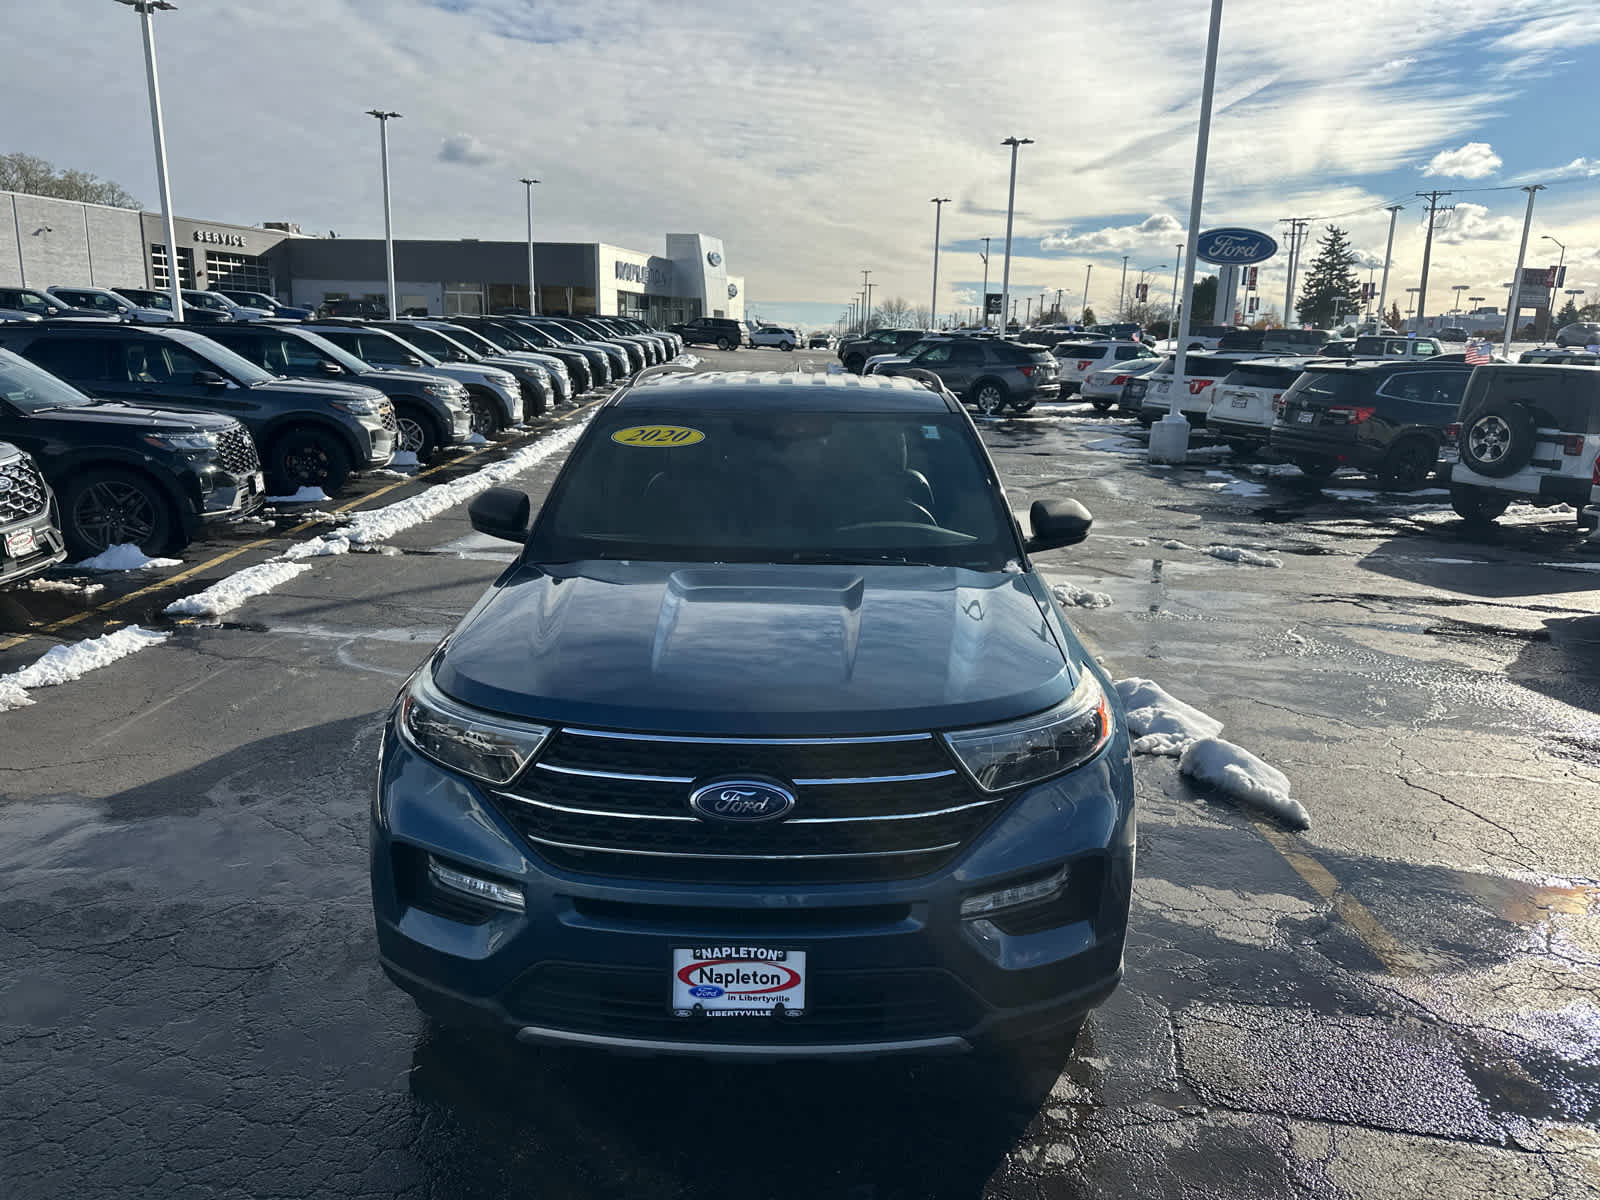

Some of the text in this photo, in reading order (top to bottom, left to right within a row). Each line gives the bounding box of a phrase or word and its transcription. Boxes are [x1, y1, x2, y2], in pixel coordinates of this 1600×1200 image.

[196, 230, 247, 247] SERVICE
[1208, 235, 1261, 257] Ford
[624, 429, 692, 442] 2020
[714, 790, 771, 812] Ford
[702, 947, 777, 960] NAPLETON
[699, 968, 781, 988] Napleton
[695, 987, 718, 997] Ford
[738, 994, 790, 1003] Libertyville
